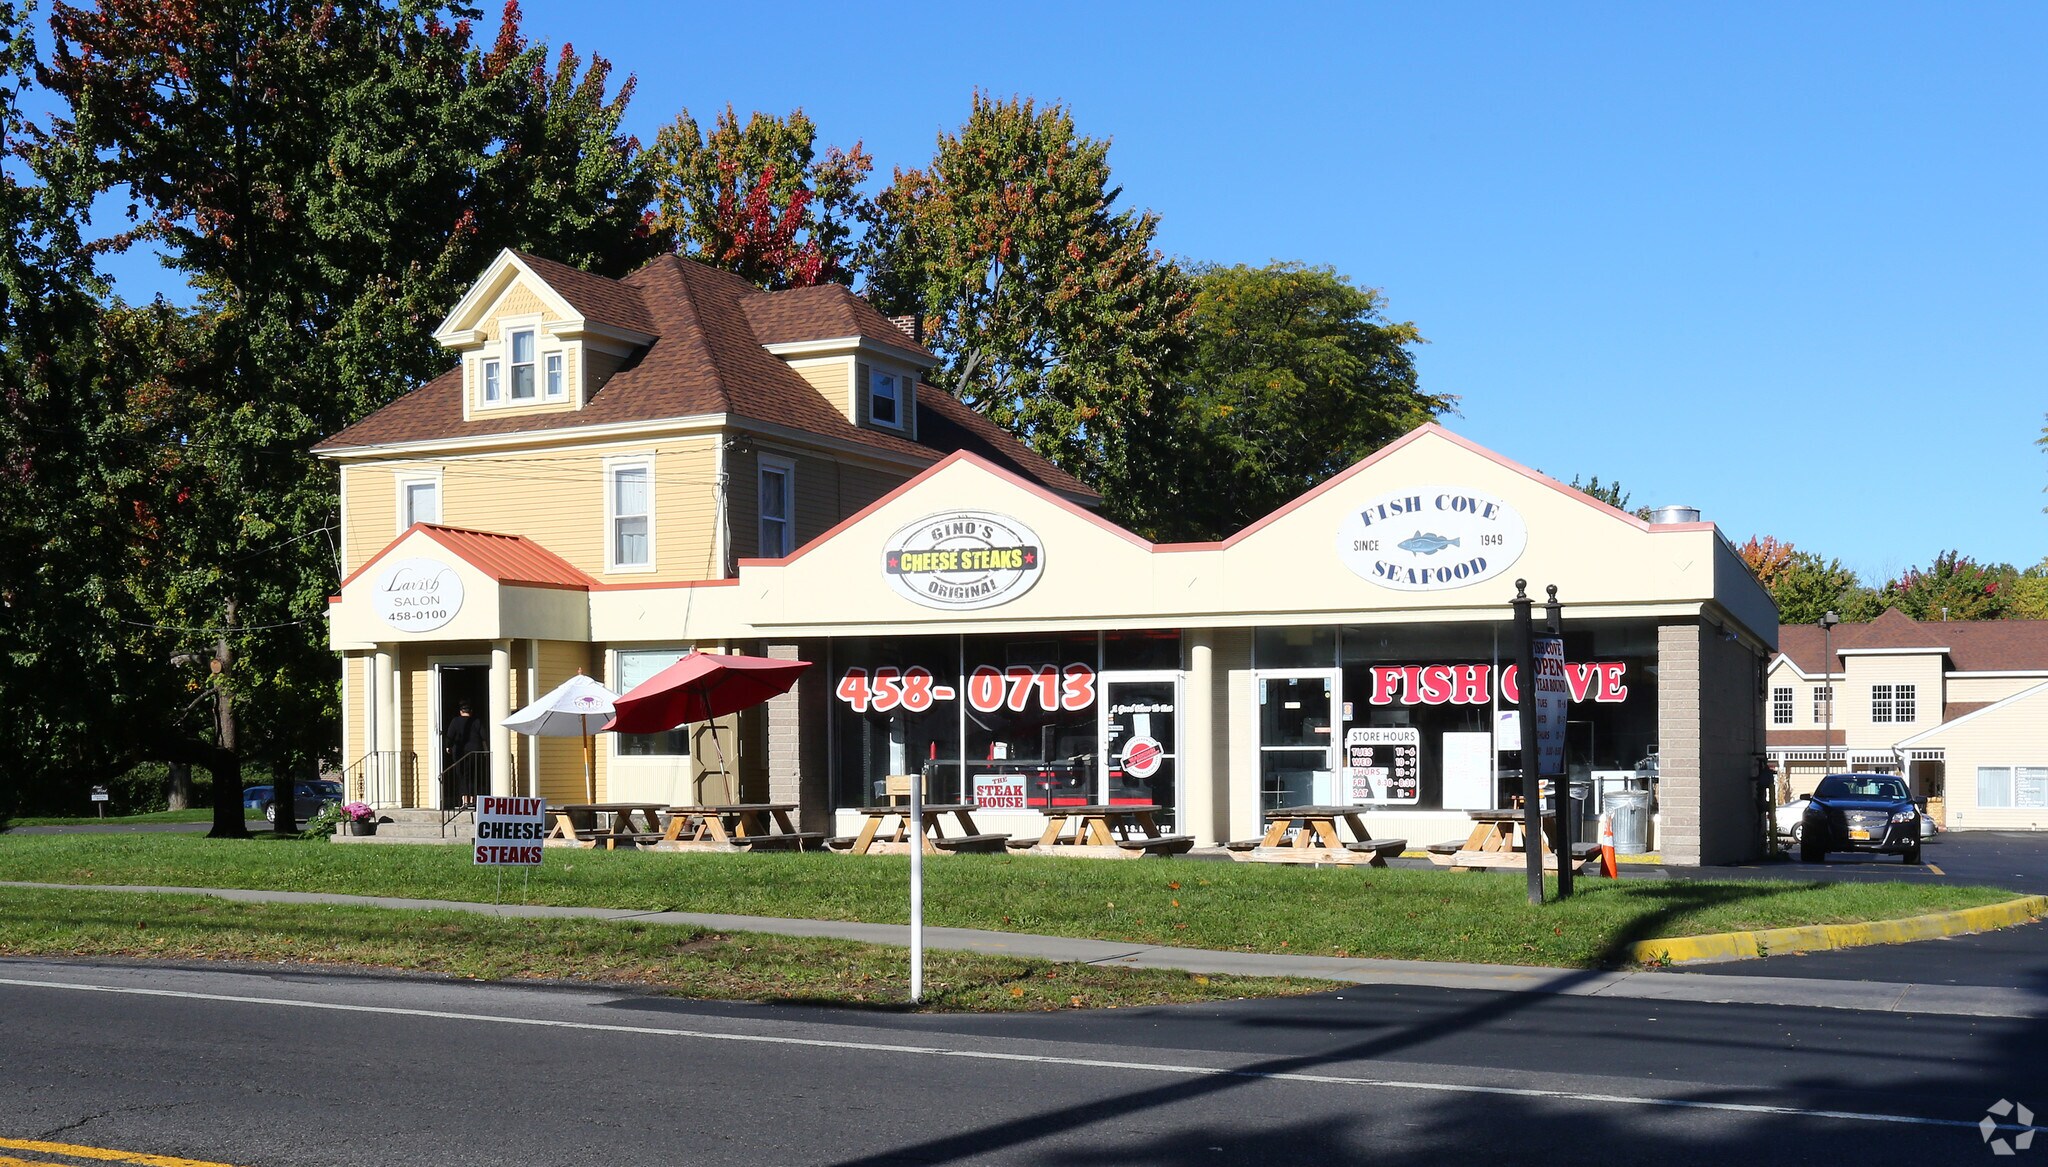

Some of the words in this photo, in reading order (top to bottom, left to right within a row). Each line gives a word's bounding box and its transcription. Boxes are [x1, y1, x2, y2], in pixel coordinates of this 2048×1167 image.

[1360, 495, 1422, 527] FISH
[1434, 494, 1500, 521] COVE
[931, 522, 994, 541] GINO'S
[1353, 540, 1379, 551] SINCE
[1480, 534, 1503, 546] 1949
[901, 552, 958, 572] CHEESE
[961, 549, 1024, 570] STEAKS
[1372, 556, 1487, 584] SEAFOOD
[381, 567, 452, 594] Lavish
[928, 578, 998, 599] ORIGINAL
[394, 595, 440, 607] SALON
[388, 609, 447, 621] 458-0100
[1533, 641, 1546, 655] ISH
[1546, 642, 1562, 656] COVE
[1534, 657, 1564, 676] OPEN
[836, 665, 956, 712] 458-
[967, 663, 1096, 712] 0713
[1369, 664, 1491, 705] FISH
[1501, 662, 1628, 703] CVE
[1535, 678, 1549, 692] YEAR
[1549, 679, 1566, 693] ROUND
[1537, 699, 1547, 708] TUES
[1353, 731, 1380, 741] STORE
[1383, 731, 1415, 741] HOURS
[1351, 747, 1373, 757] TUES
[1351, 757, 1372, 767] WED
[1353, 768, 1381, 776] THURS
[992, 776, 1008, 785] THE
[1352, 778, 1366, 787] FRI
[977, 785, 1024, 796] STEAK
[1352, 788, 1369, 798] SAT
[484, 797, 541, 816] PHILLY
[977, 797, 1024, 808] HOUSE
[478, 821, 543, 840] CHEESE
[1160, 824, 1172, 833] ST
[476, 846, 542, 864] STEAKS
